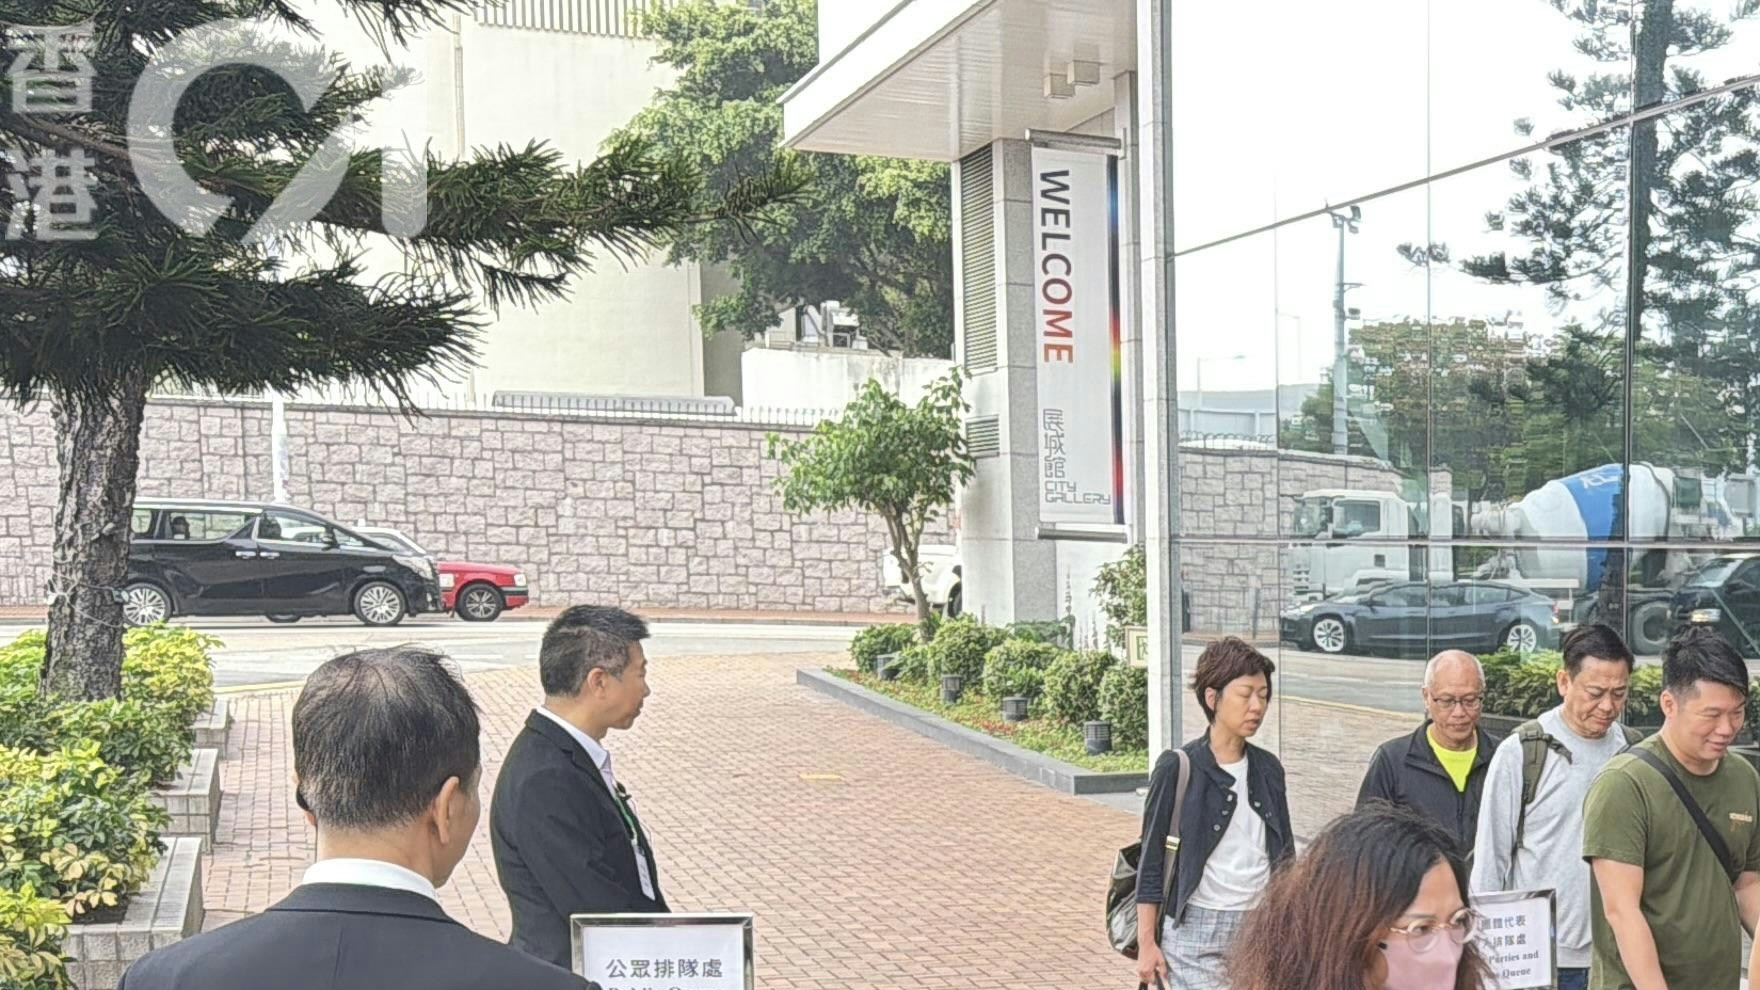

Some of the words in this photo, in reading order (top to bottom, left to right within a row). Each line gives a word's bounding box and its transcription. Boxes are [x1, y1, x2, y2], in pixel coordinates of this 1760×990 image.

[1040, 169, 1073, 364] WELCOME
[1042, 408, 1067, 479] 展城館
[1044, 480, 1077, 493] CITY
[1045, 491, 1111, 505] GALLERY
[1522, 949, 1539, 960] and
[606, 958, 723, 979] 公眾排隊處
[1502, 968, 1531, 980] Queue
